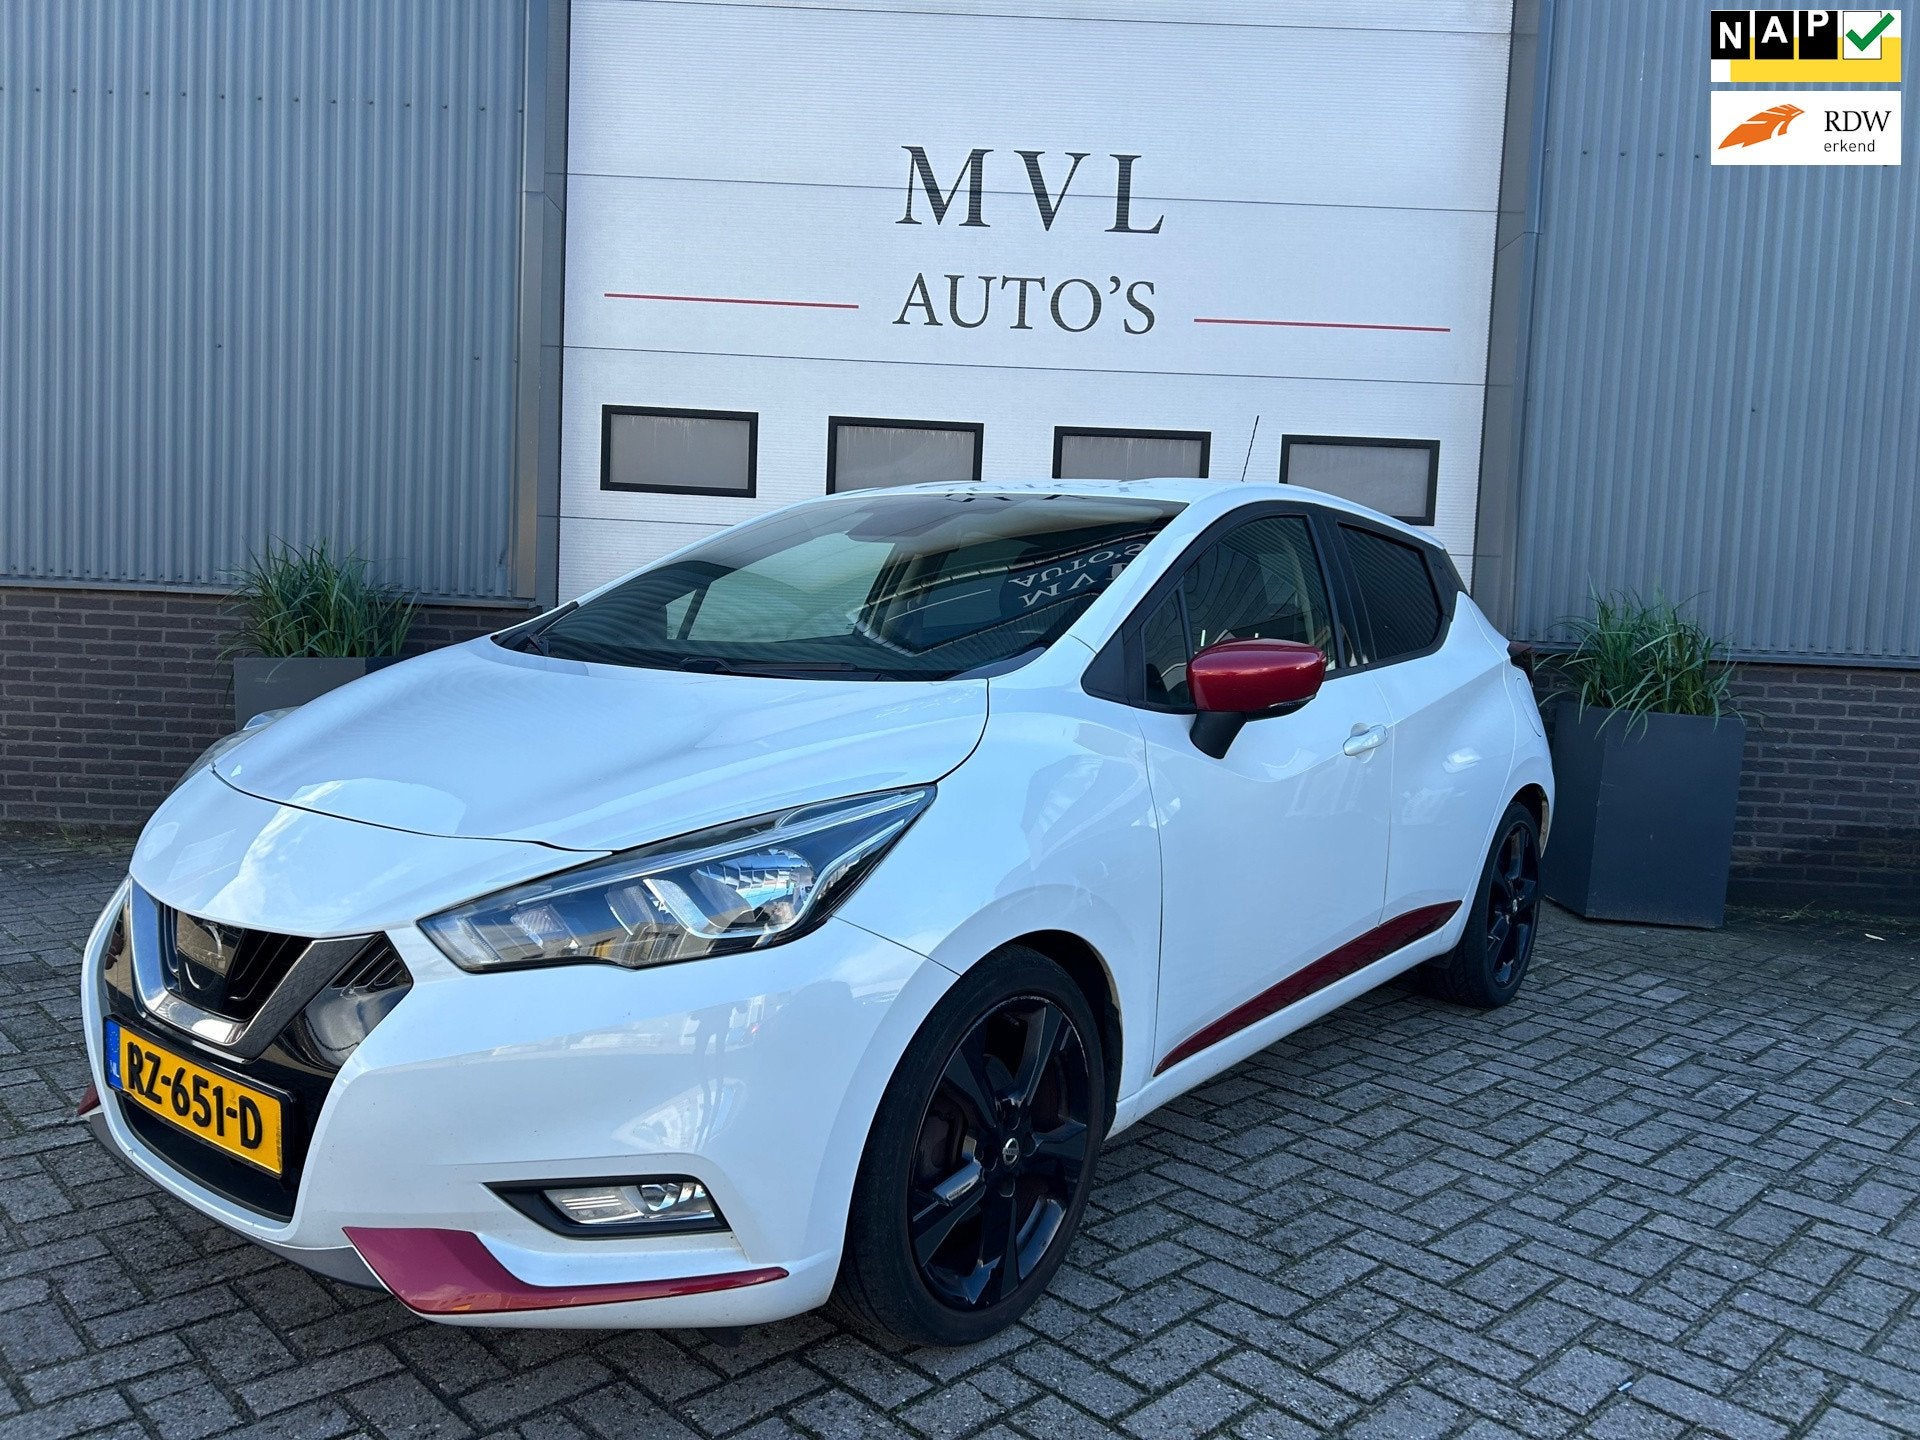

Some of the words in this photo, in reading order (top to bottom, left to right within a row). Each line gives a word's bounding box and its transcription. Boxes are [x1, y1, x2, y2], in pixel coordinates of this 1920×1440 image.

[895, 145, 1165, 235] MVL
[892, 272, 1156, 335] AUTO'S
[126, 1041, 263, 1150] RZ-651-D
